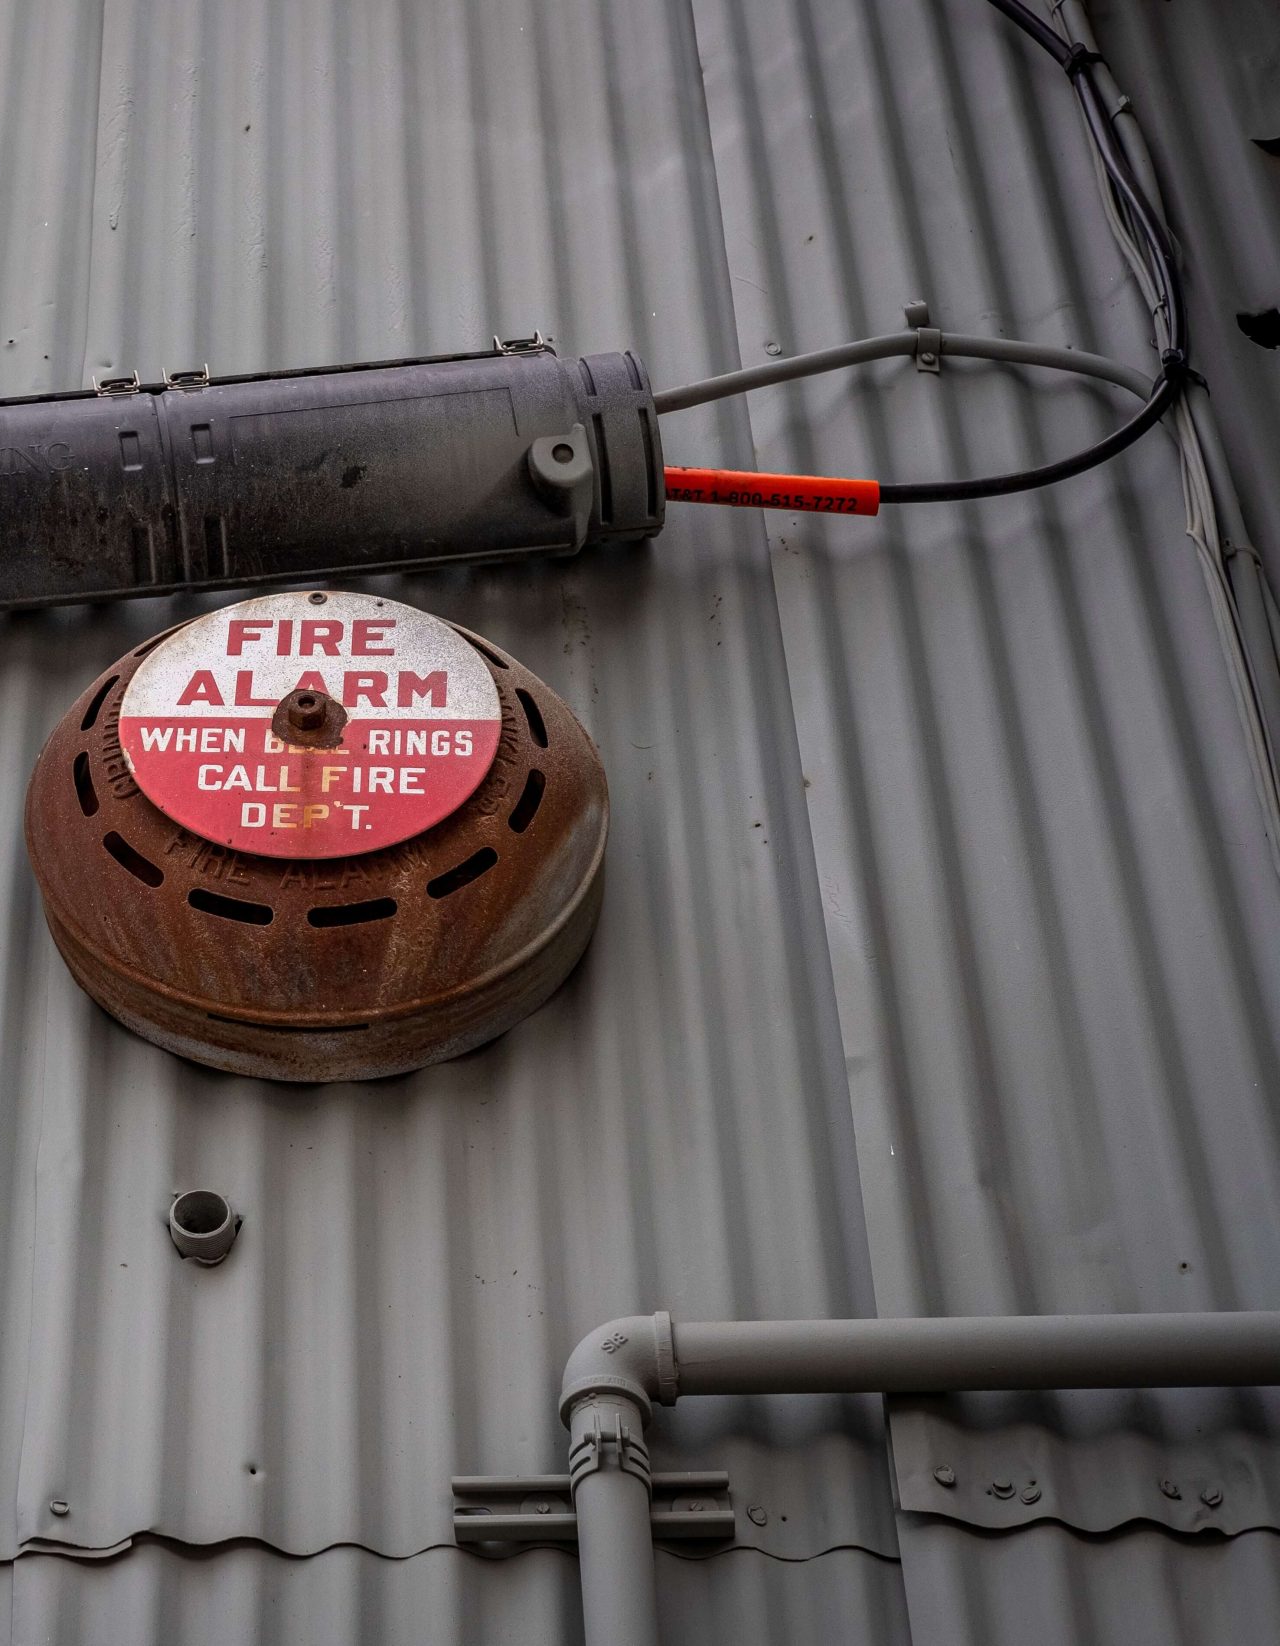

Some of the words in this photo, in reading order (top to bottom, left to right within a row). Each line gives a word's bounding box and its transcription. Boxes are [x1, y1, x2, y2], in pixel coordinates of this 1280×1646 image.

[710, 491, 858, 512] 1-800-515-7272
[226, 619, 397, 656] FIRE
[140, 727, 246, 753] WHEN
[368, 729, 474, 756] RINGS
[197, 764, 301, 792] CALL
[321, 766, 426, 795] FIRE
